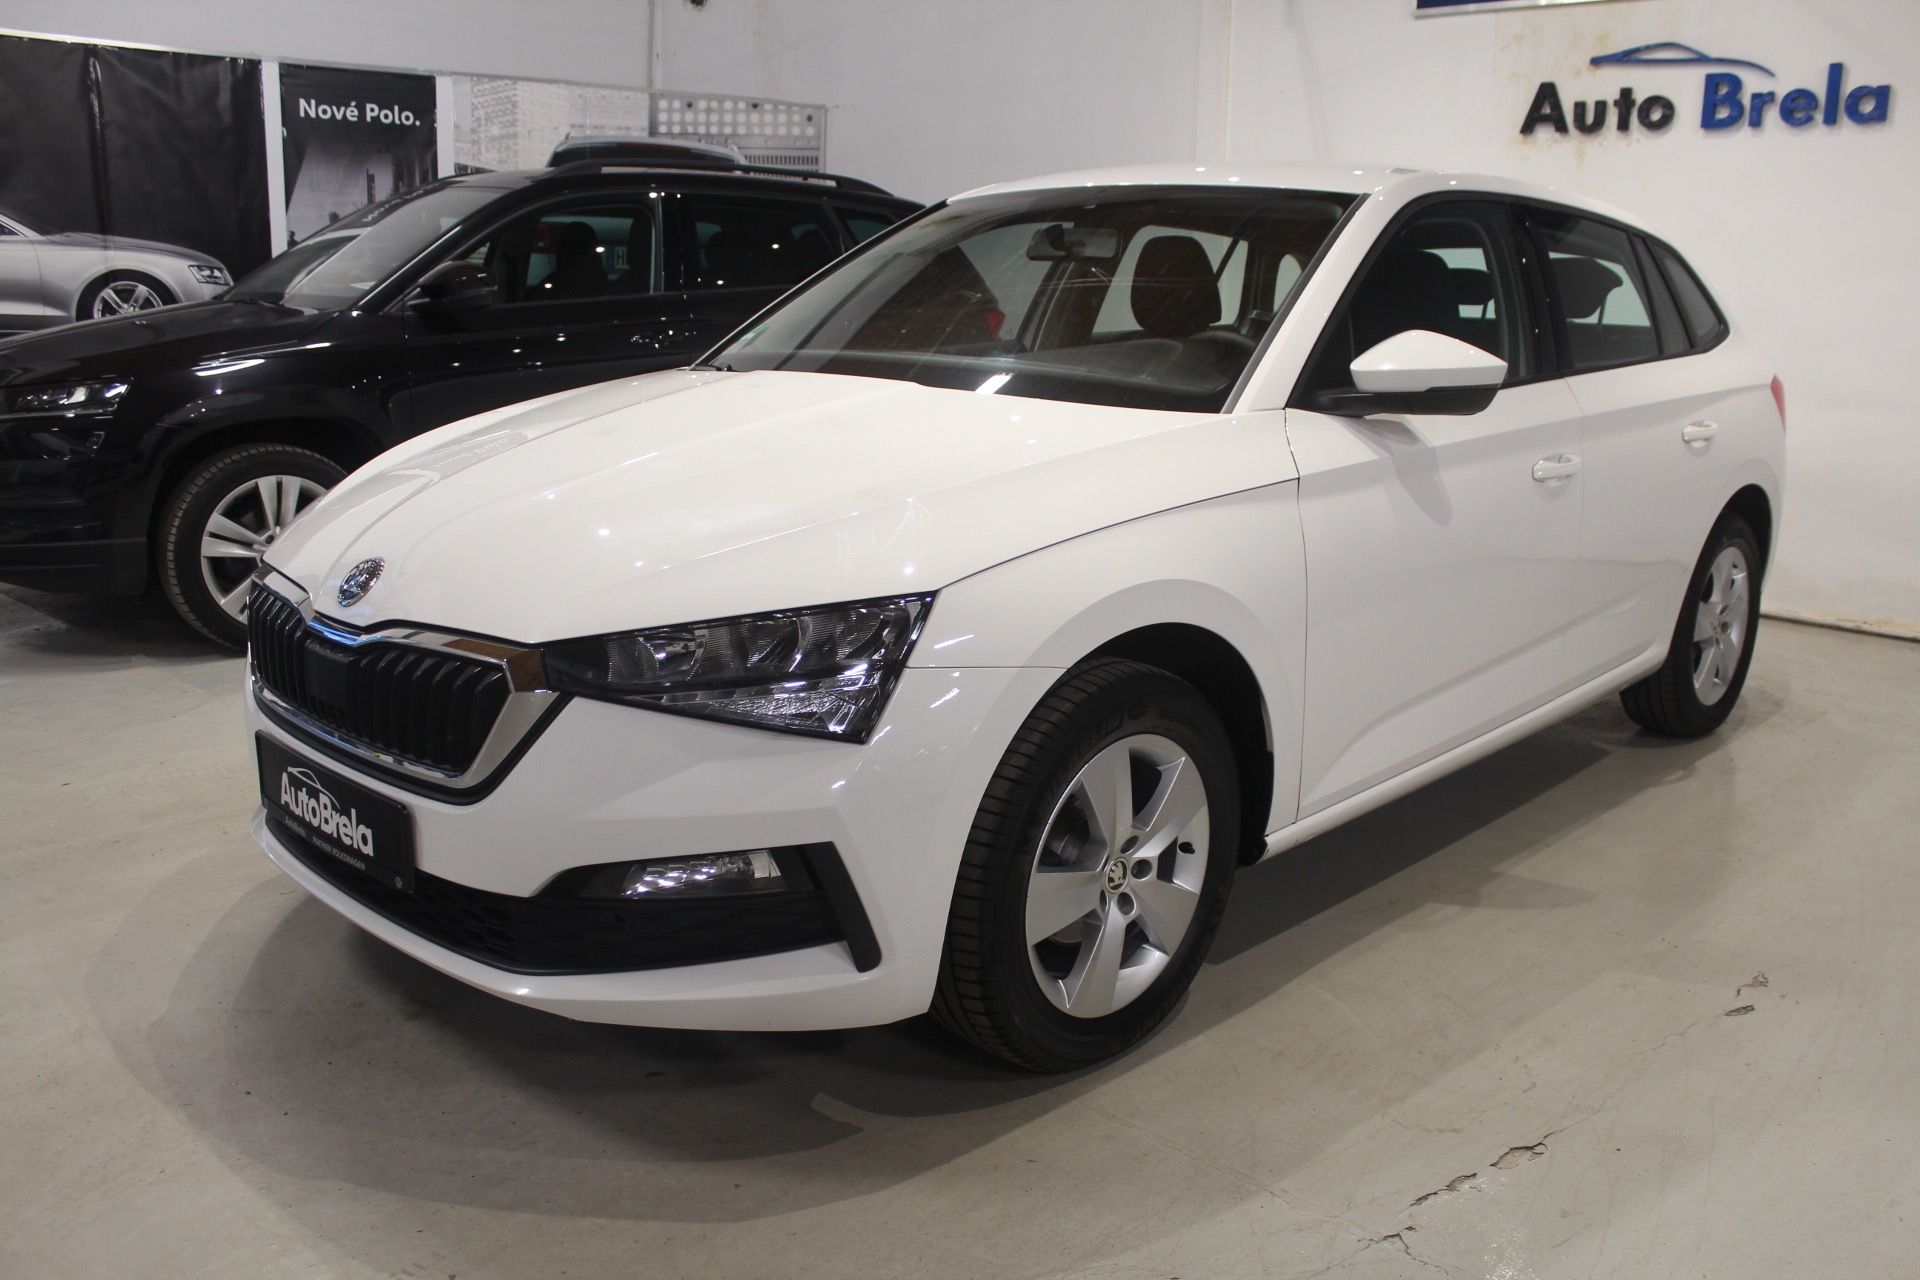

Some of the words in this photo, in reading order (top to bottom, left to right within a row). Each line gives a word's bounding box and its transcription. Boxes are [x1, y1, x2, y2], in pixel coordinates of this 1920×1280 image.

[299, 97, 359, 121] Nové
[365, 103, 421, 126] Polo.
[1520, 81, 1676, 134] Auto
[1700, 62, 1892, 129] Brela
[280, 771, 374, 857] AutoBrela
